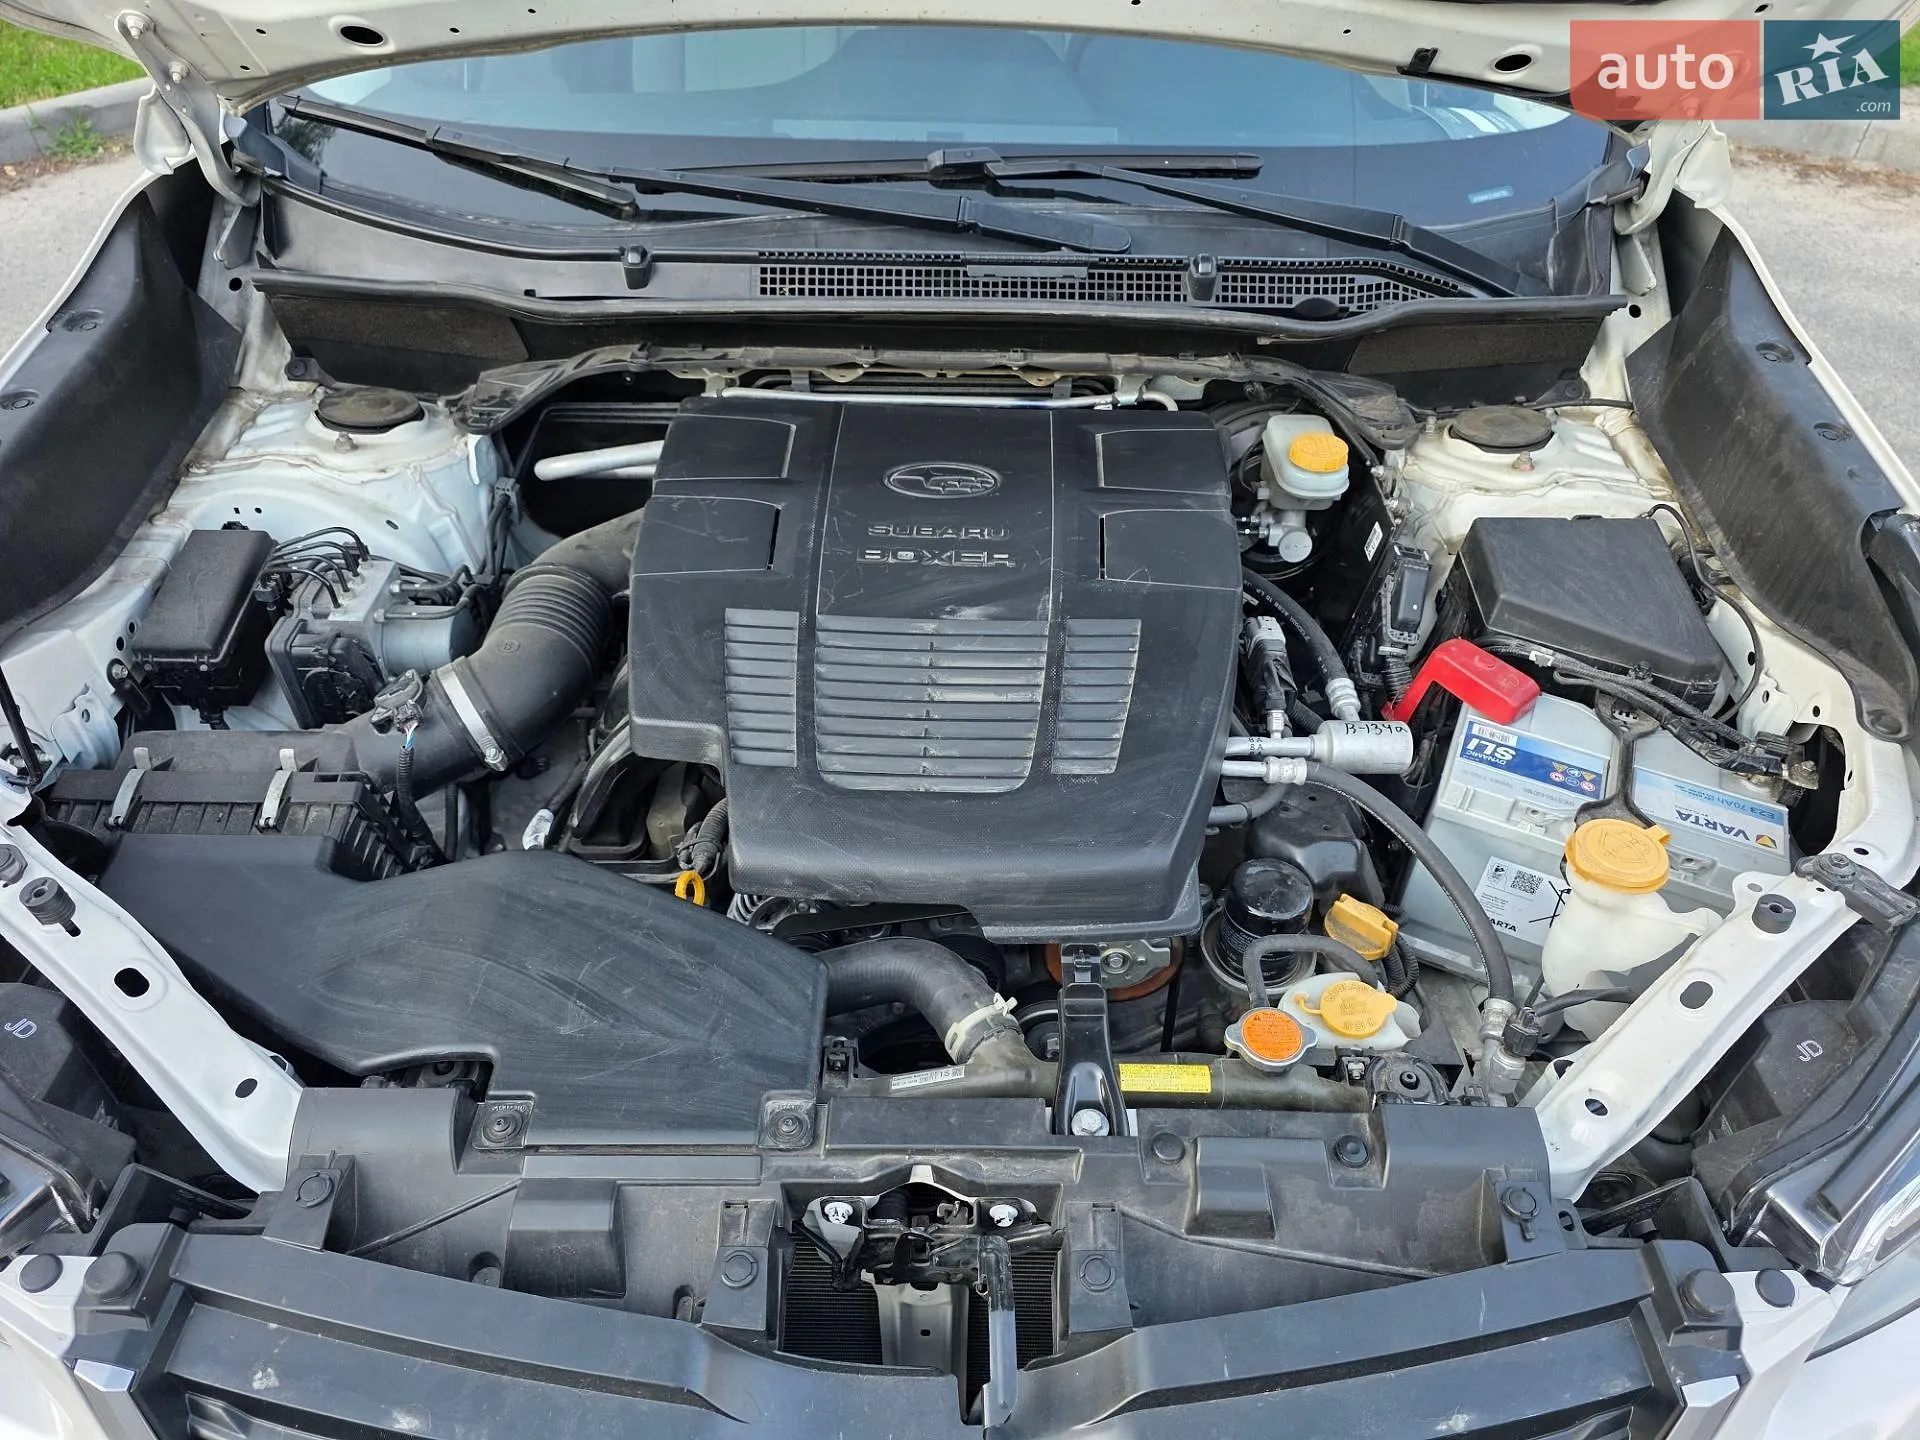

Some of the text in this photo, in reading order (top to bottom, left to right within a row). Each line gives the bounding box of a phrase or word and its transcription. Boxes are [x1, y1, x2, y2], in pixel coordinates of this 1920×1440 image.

[868, 524, 1010, 540] SUBARU
[856, 549, 1016, 567] BOXER
[1465, 749, 1507, 766] DYNAMIC
[1466, 737, 1516, 761] SLI
[1675, 809, 1750, 841] VARTA
[1489, 918, 1517, 933] ARTA
[3, 1017, 38, 1039] JD
[1796, 1040, 1823, 1062] JD
